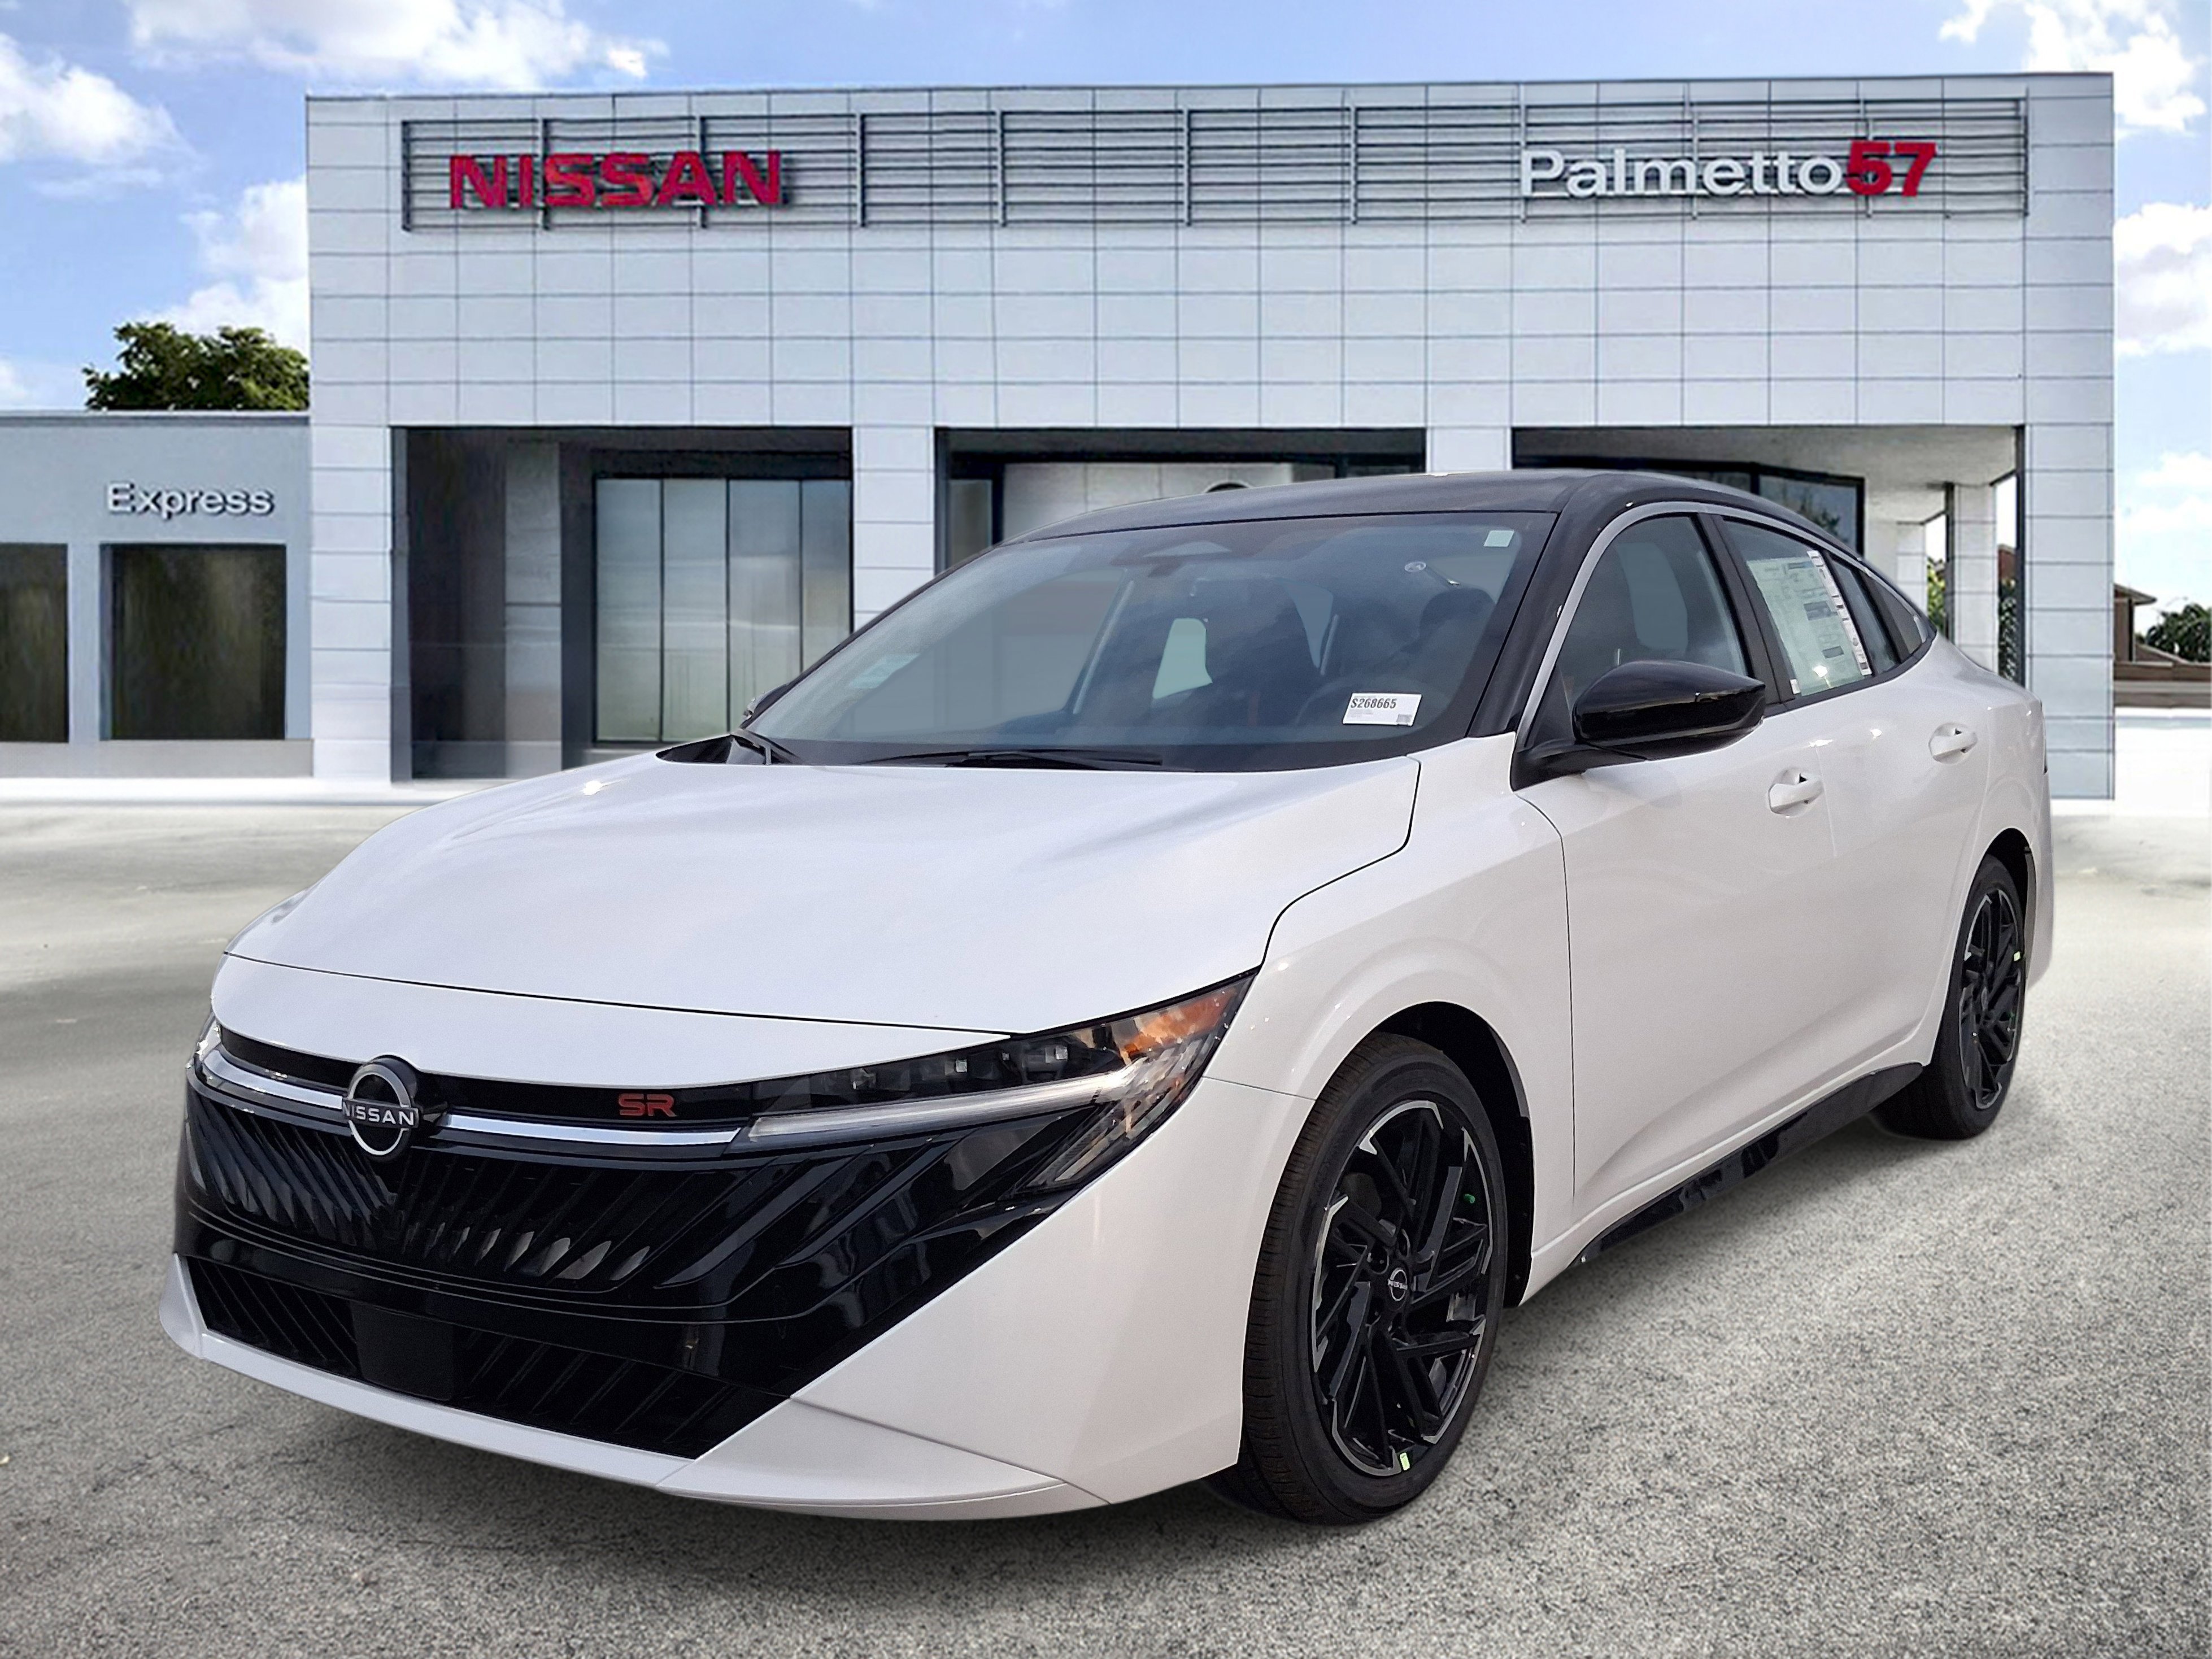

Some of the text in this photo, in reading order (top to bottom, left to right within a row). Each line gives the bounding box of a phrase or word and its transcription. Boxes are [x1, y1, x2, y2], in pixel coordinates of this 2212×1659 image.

[450, 150, 781, 209] NISSAN
[108, 482, 275, 520] Express
[342, 1101, 414, 1126] NISSAN
[619, 1093, 677, 1117] SR
